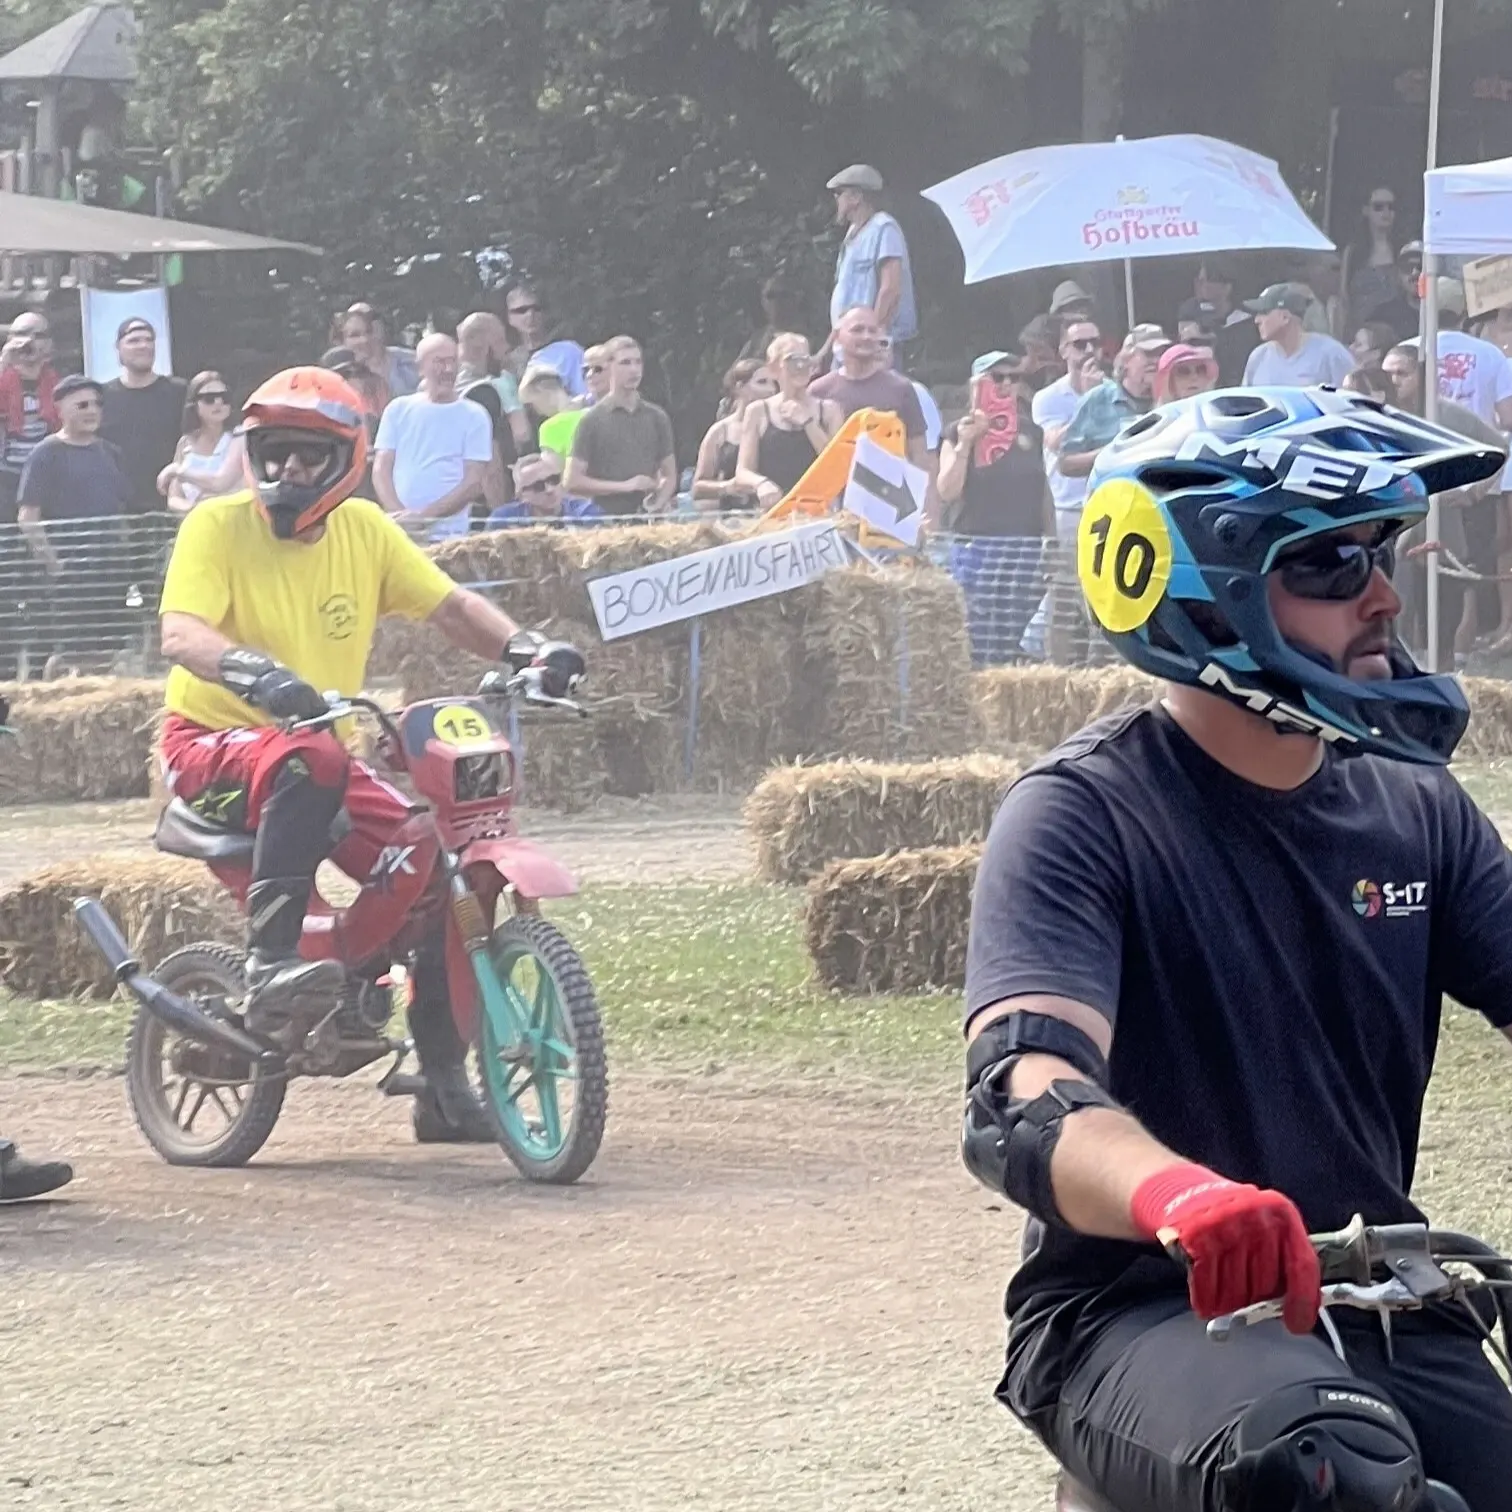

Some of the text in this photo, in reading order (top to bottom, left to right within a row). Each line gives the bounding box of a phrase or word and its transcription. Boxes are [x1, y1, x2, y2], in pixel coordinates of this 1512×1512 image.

[603, 526, 843, 628] BOXENAUSFAHRT
[1090, 513, 1156, 600] 10
[442, 718, 483, 739] 15
